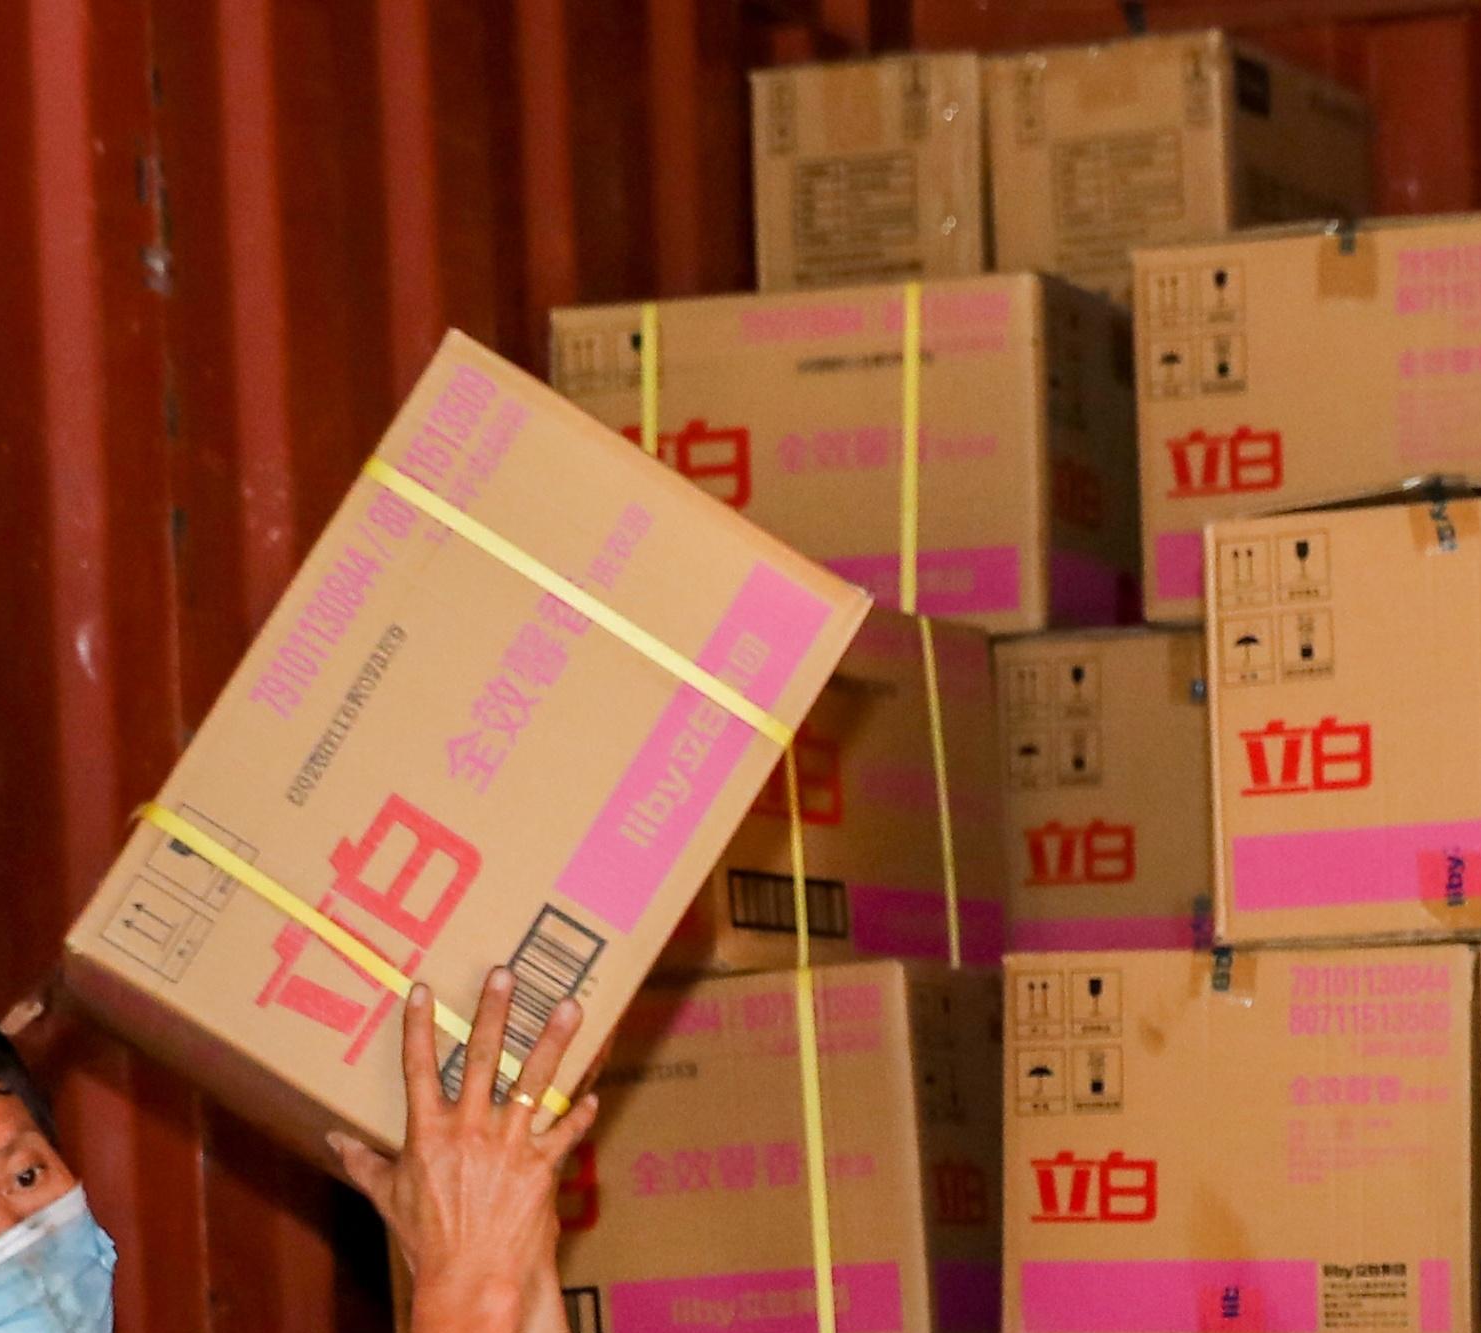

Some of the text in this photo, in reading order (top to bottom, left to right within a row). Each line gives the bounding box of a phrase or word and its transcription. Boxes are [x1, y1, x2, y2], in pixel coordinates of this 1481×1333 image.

[358, 359, 501, 542] 8011513509
[1169, 426, 1283, 496] 立白
[611, 625, 781, 853] liby立白团
[1241, 717, 1372, 796] 立白
[1029, 820, 1135, 883] 立白
[238, 779, 492, 1068] 立白
[1034, 1151, 1157, 1223] 立白
